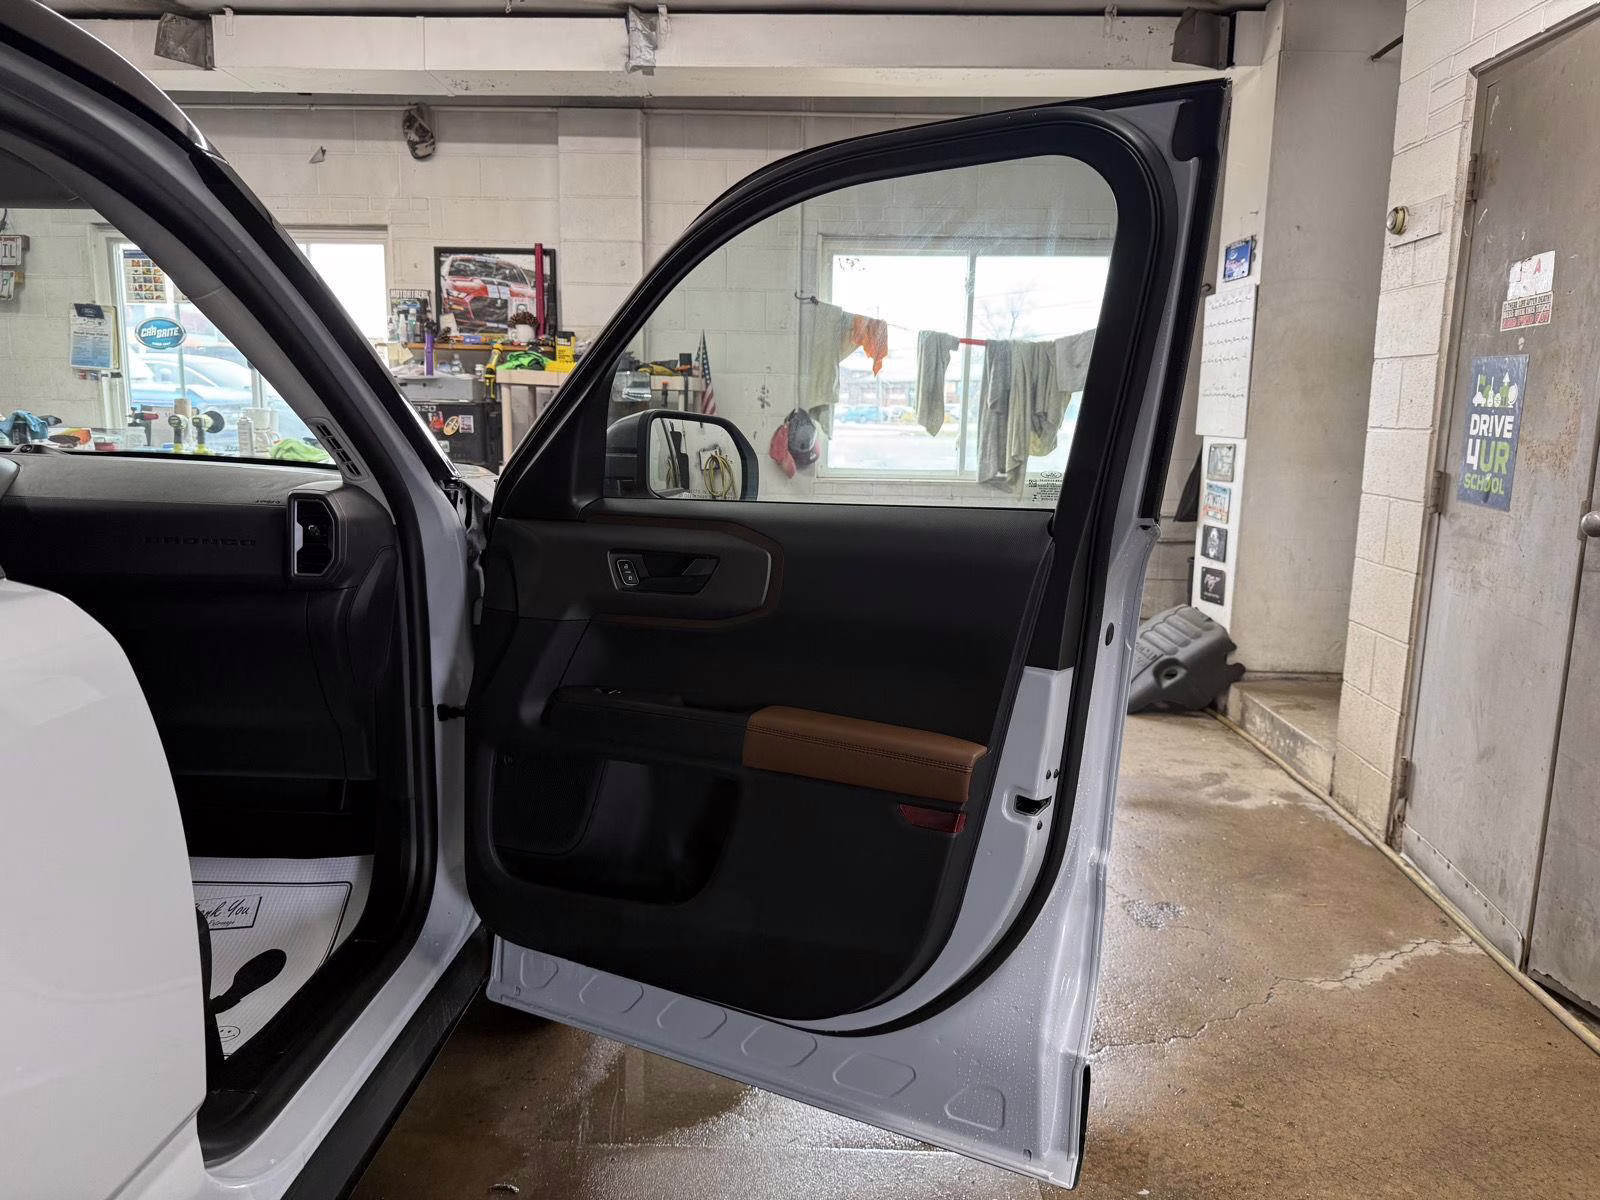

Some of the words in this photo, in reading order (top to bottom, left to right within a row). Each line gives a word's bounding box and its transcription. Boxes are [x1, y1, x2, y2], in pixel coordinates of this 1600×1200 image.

[141, 326, 157, 338] CAR
[156, 327, 179, 339] BRITE
[1463, 472, 1505, 495] SCHOOL
[227, 898, 250, 918] You
